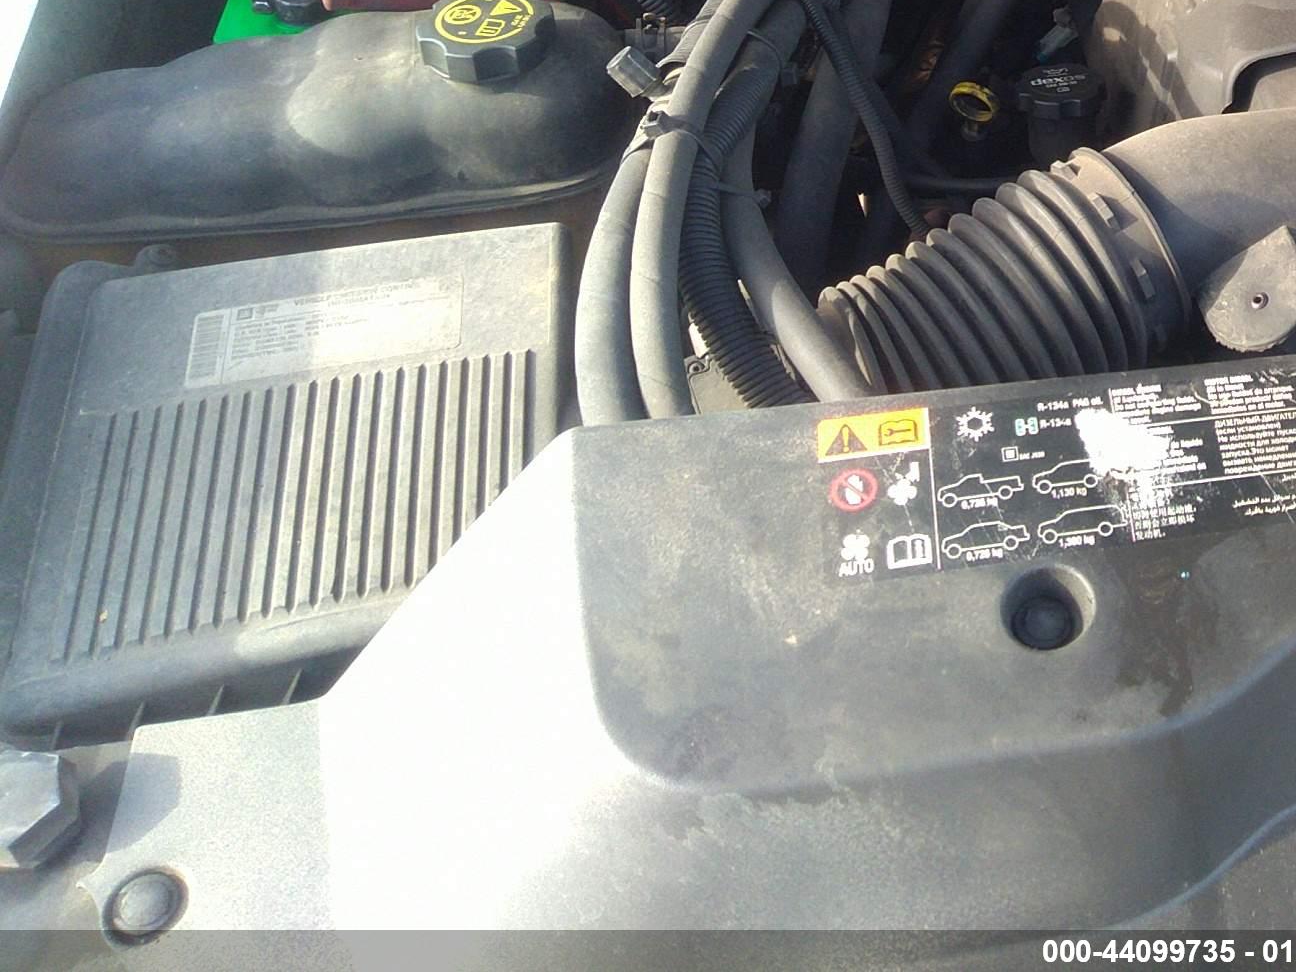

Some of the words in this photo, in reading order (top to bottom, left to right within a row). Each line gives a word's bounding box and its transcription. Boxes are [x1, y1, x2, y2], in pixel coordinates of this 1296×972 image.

[1030, 75, 1086, 86] dexos
[1076, 486, 1087, 497] kg
[839, 558, 874, 577] AUTO
